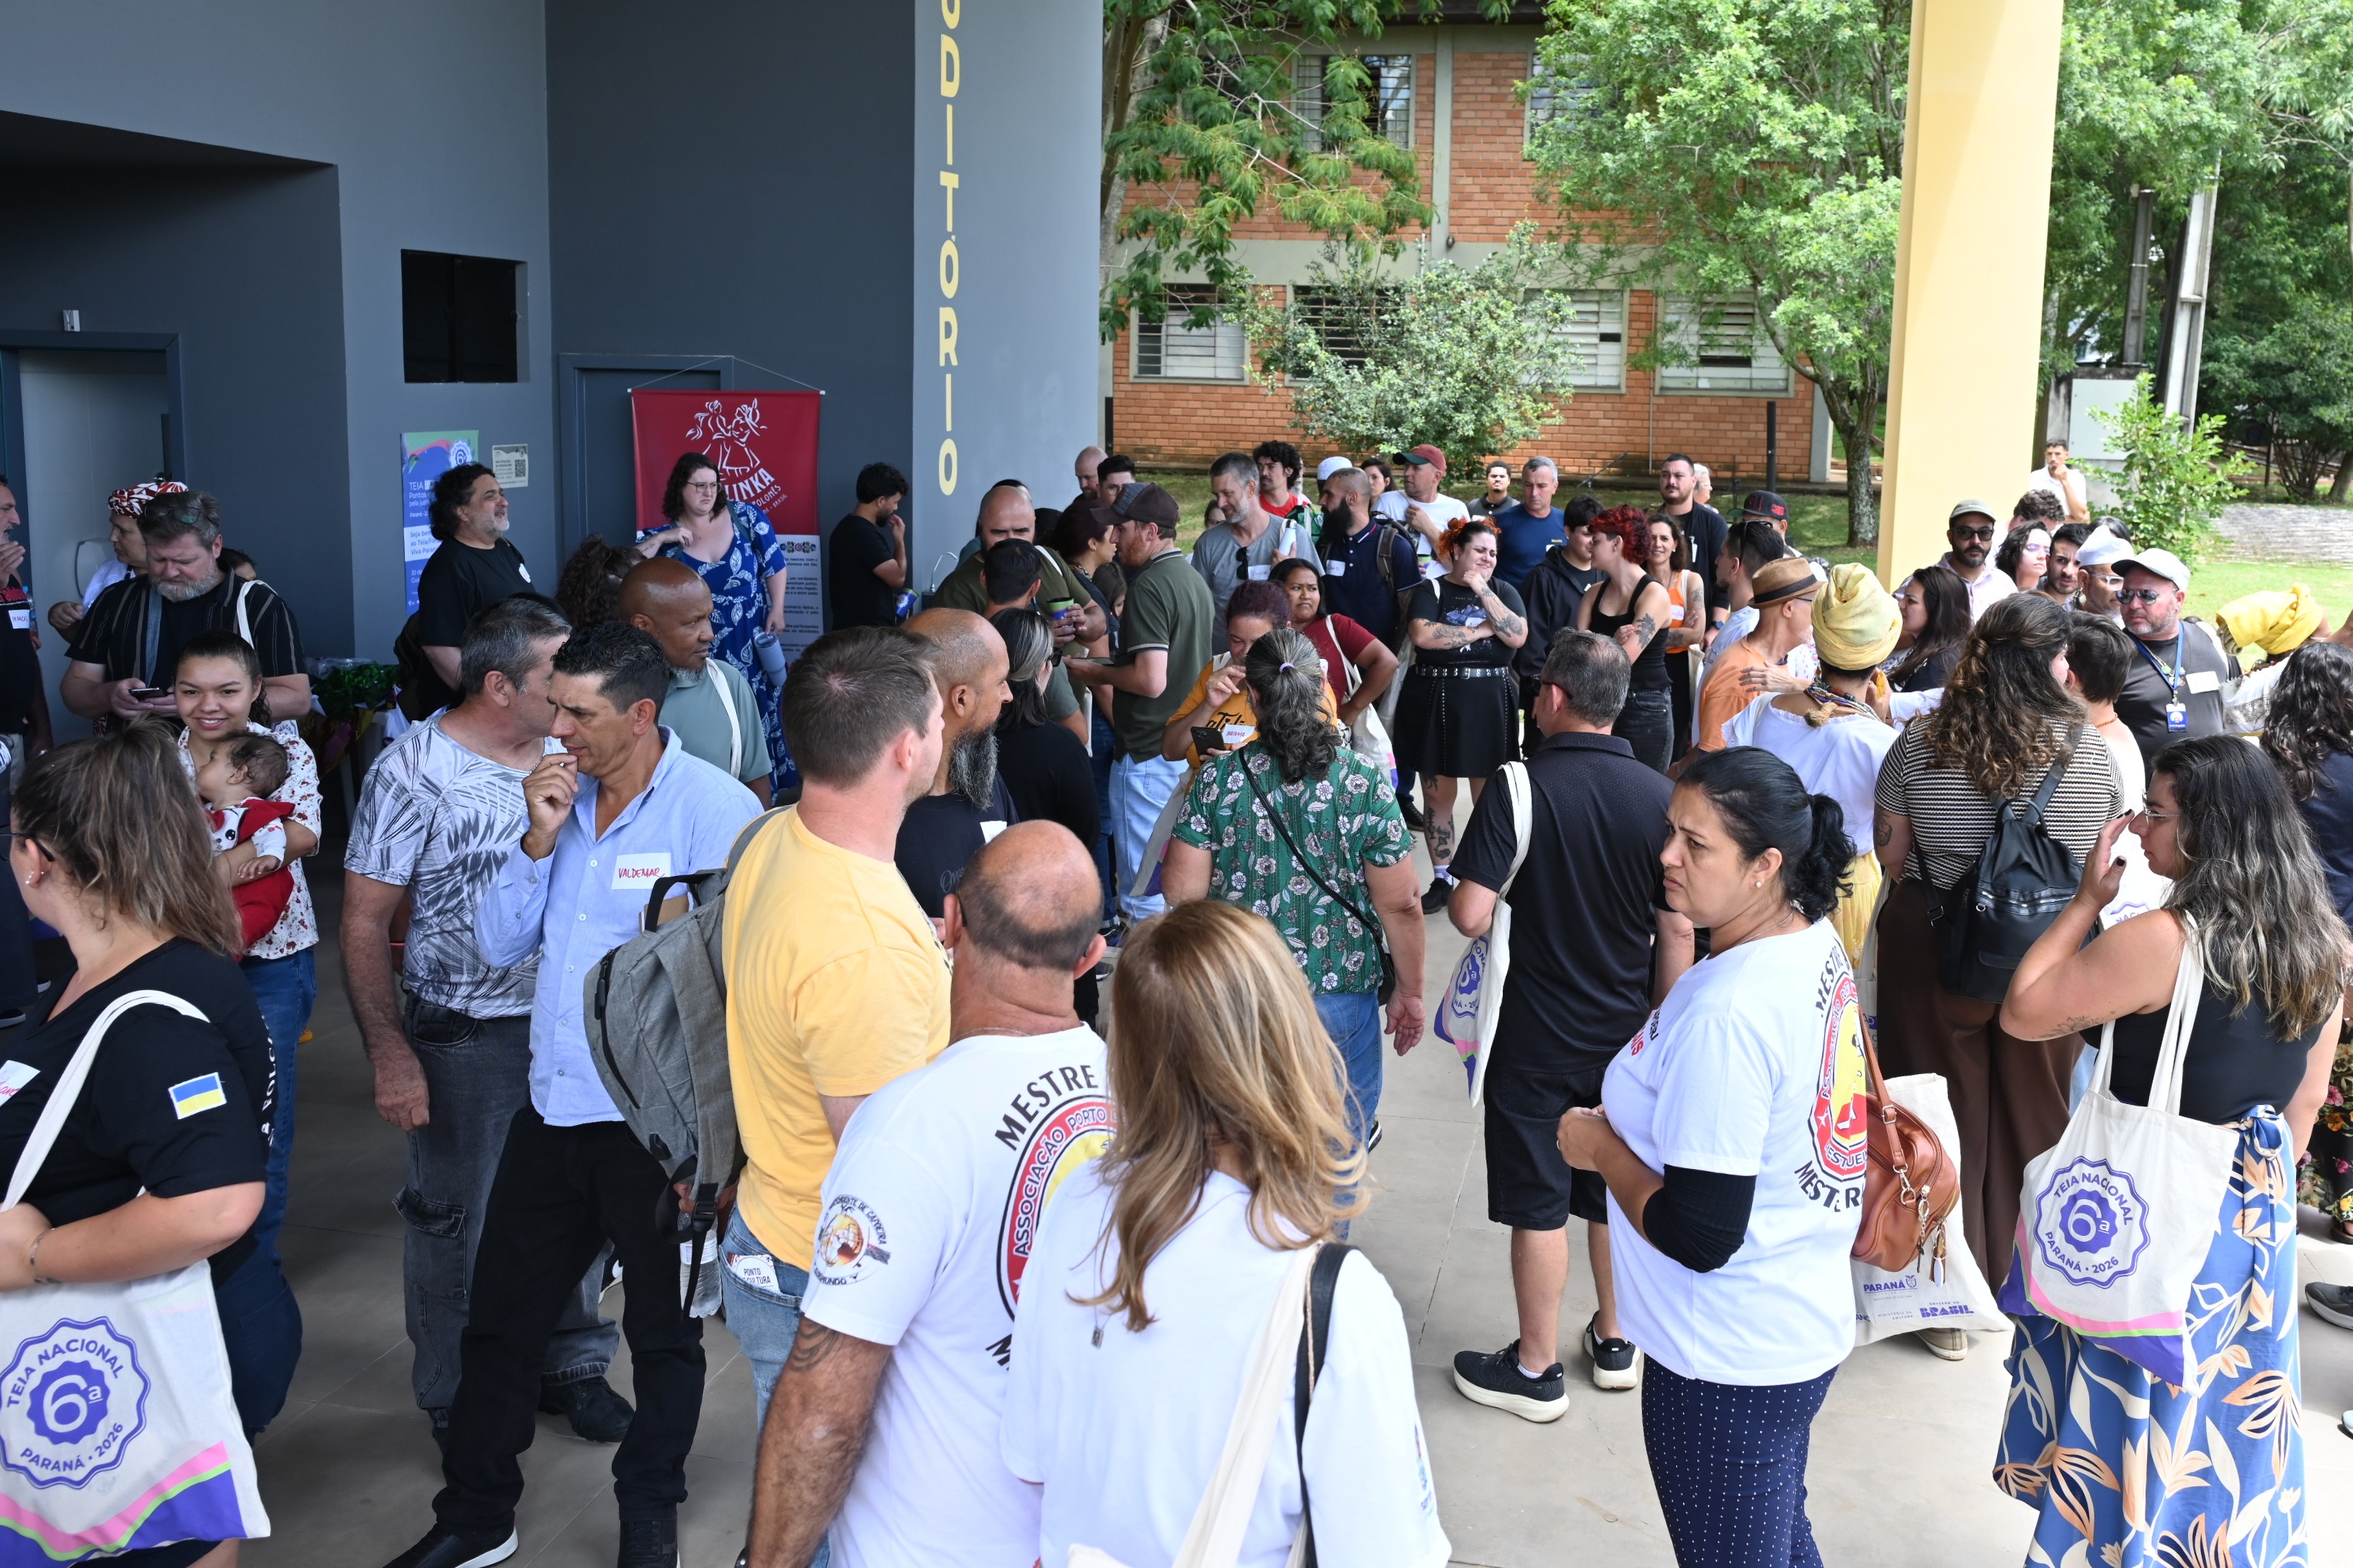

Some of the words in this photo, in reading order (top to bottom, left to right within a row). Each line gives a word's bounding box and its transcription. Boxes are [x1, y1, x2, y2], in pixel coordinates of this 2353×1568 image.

[724, 467, 775, 501] LINKA
[619, 867, 665, 878] VALDEMAR
[995, 1065, 1099, 1152] MESTRE
[1014, 1128, 1065, 1256] ASSOCIAÇÃO
[1068, 1108, 1106, 1132] PORTO
[2054, 1175, 2079, 1199] TEIA
[2081, 1173, 2133, 1225] NACIONAL
[2045, 1231, 2081, 1273] PARANÁ
[2091, 1256, 2119, 1273] 2026
[744, 1268, 761, 1276] PONTO
[1863, 1280, 1906, 1292] PARANÁ
[1856, 1314, 1870, 1322] ANC
[1919, 1304, 1974, 1318] BRASIL
[6, 1366, 35, 1408] TEIA
[37, 1339, 124, 1379] NACIONAL
[21, 1447, 85, 1472] PARANÁ
[95, 1423, 124, 1458] 2026
